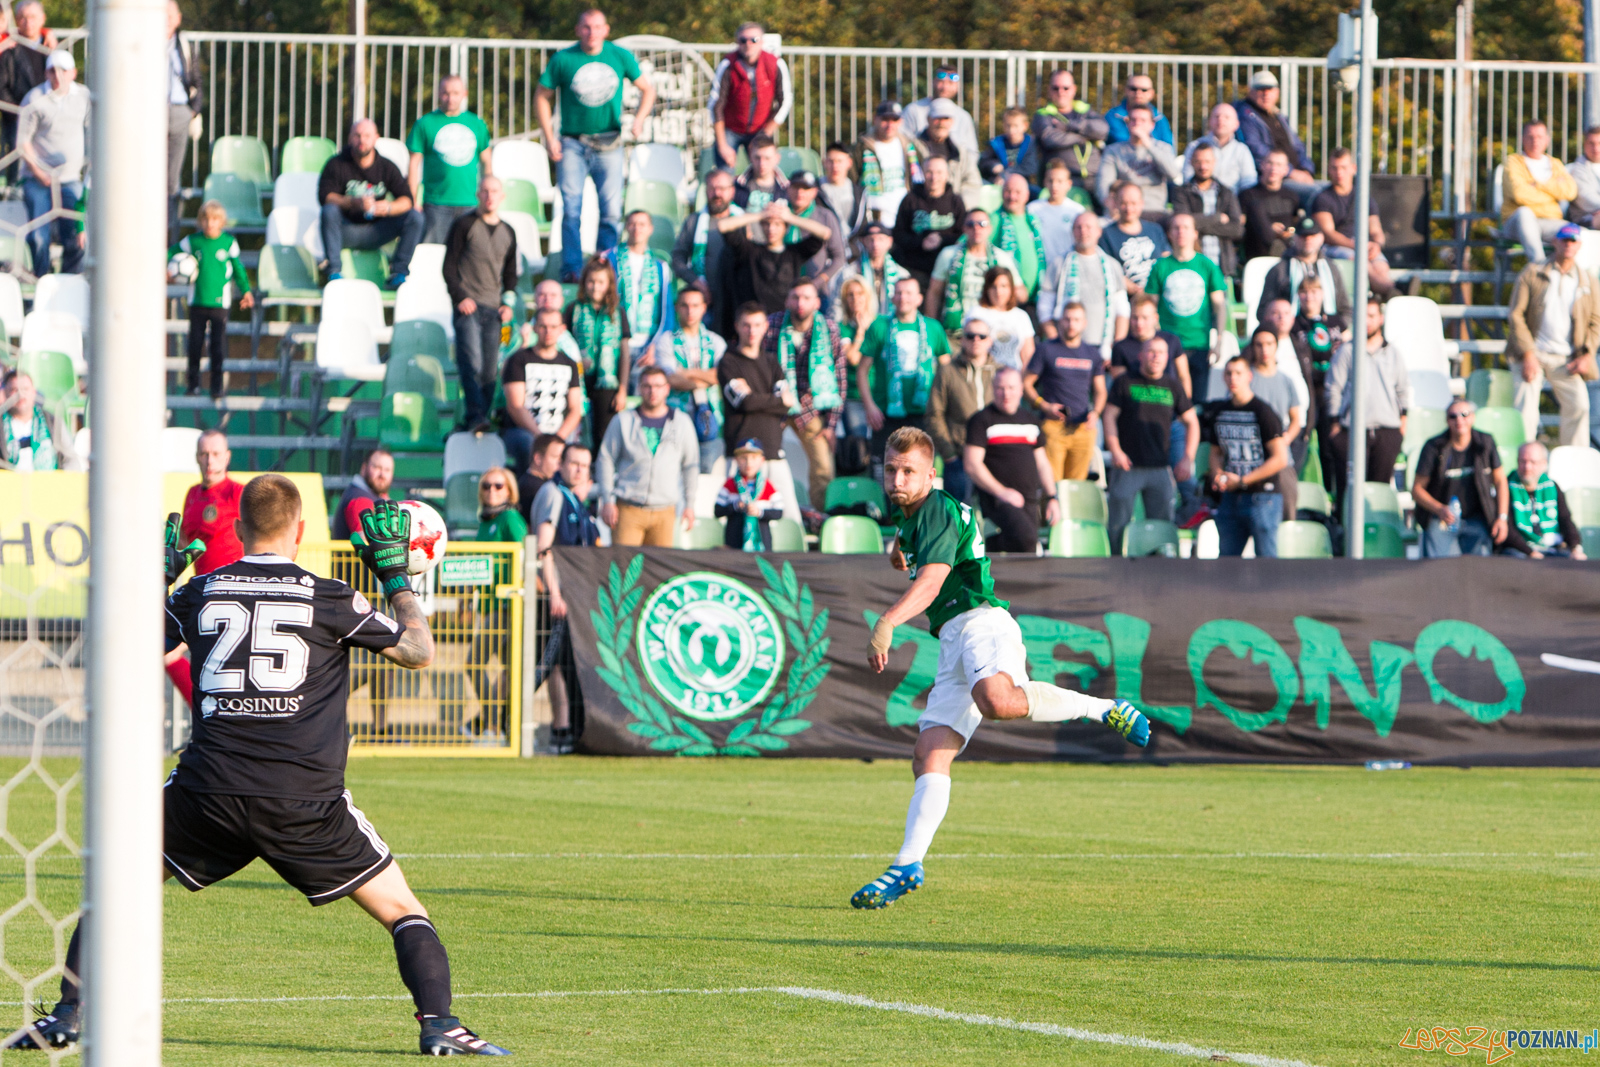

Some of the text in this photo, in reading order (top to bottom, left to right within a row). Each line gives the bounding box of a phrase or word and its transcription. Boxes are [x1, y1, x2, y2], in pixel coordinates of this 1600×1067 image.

[374, 546, 405, 560] FOOTBALL
[376, 555, 406, 568] MASTERS
[206, 574, 297, 584] DORGAS
[648, 584, 700, 662] WARTA
[198, 601, 315, 693] 25
[218, 697, 300, 713] COSINUS
[681, 689, 743, 712] 1912
